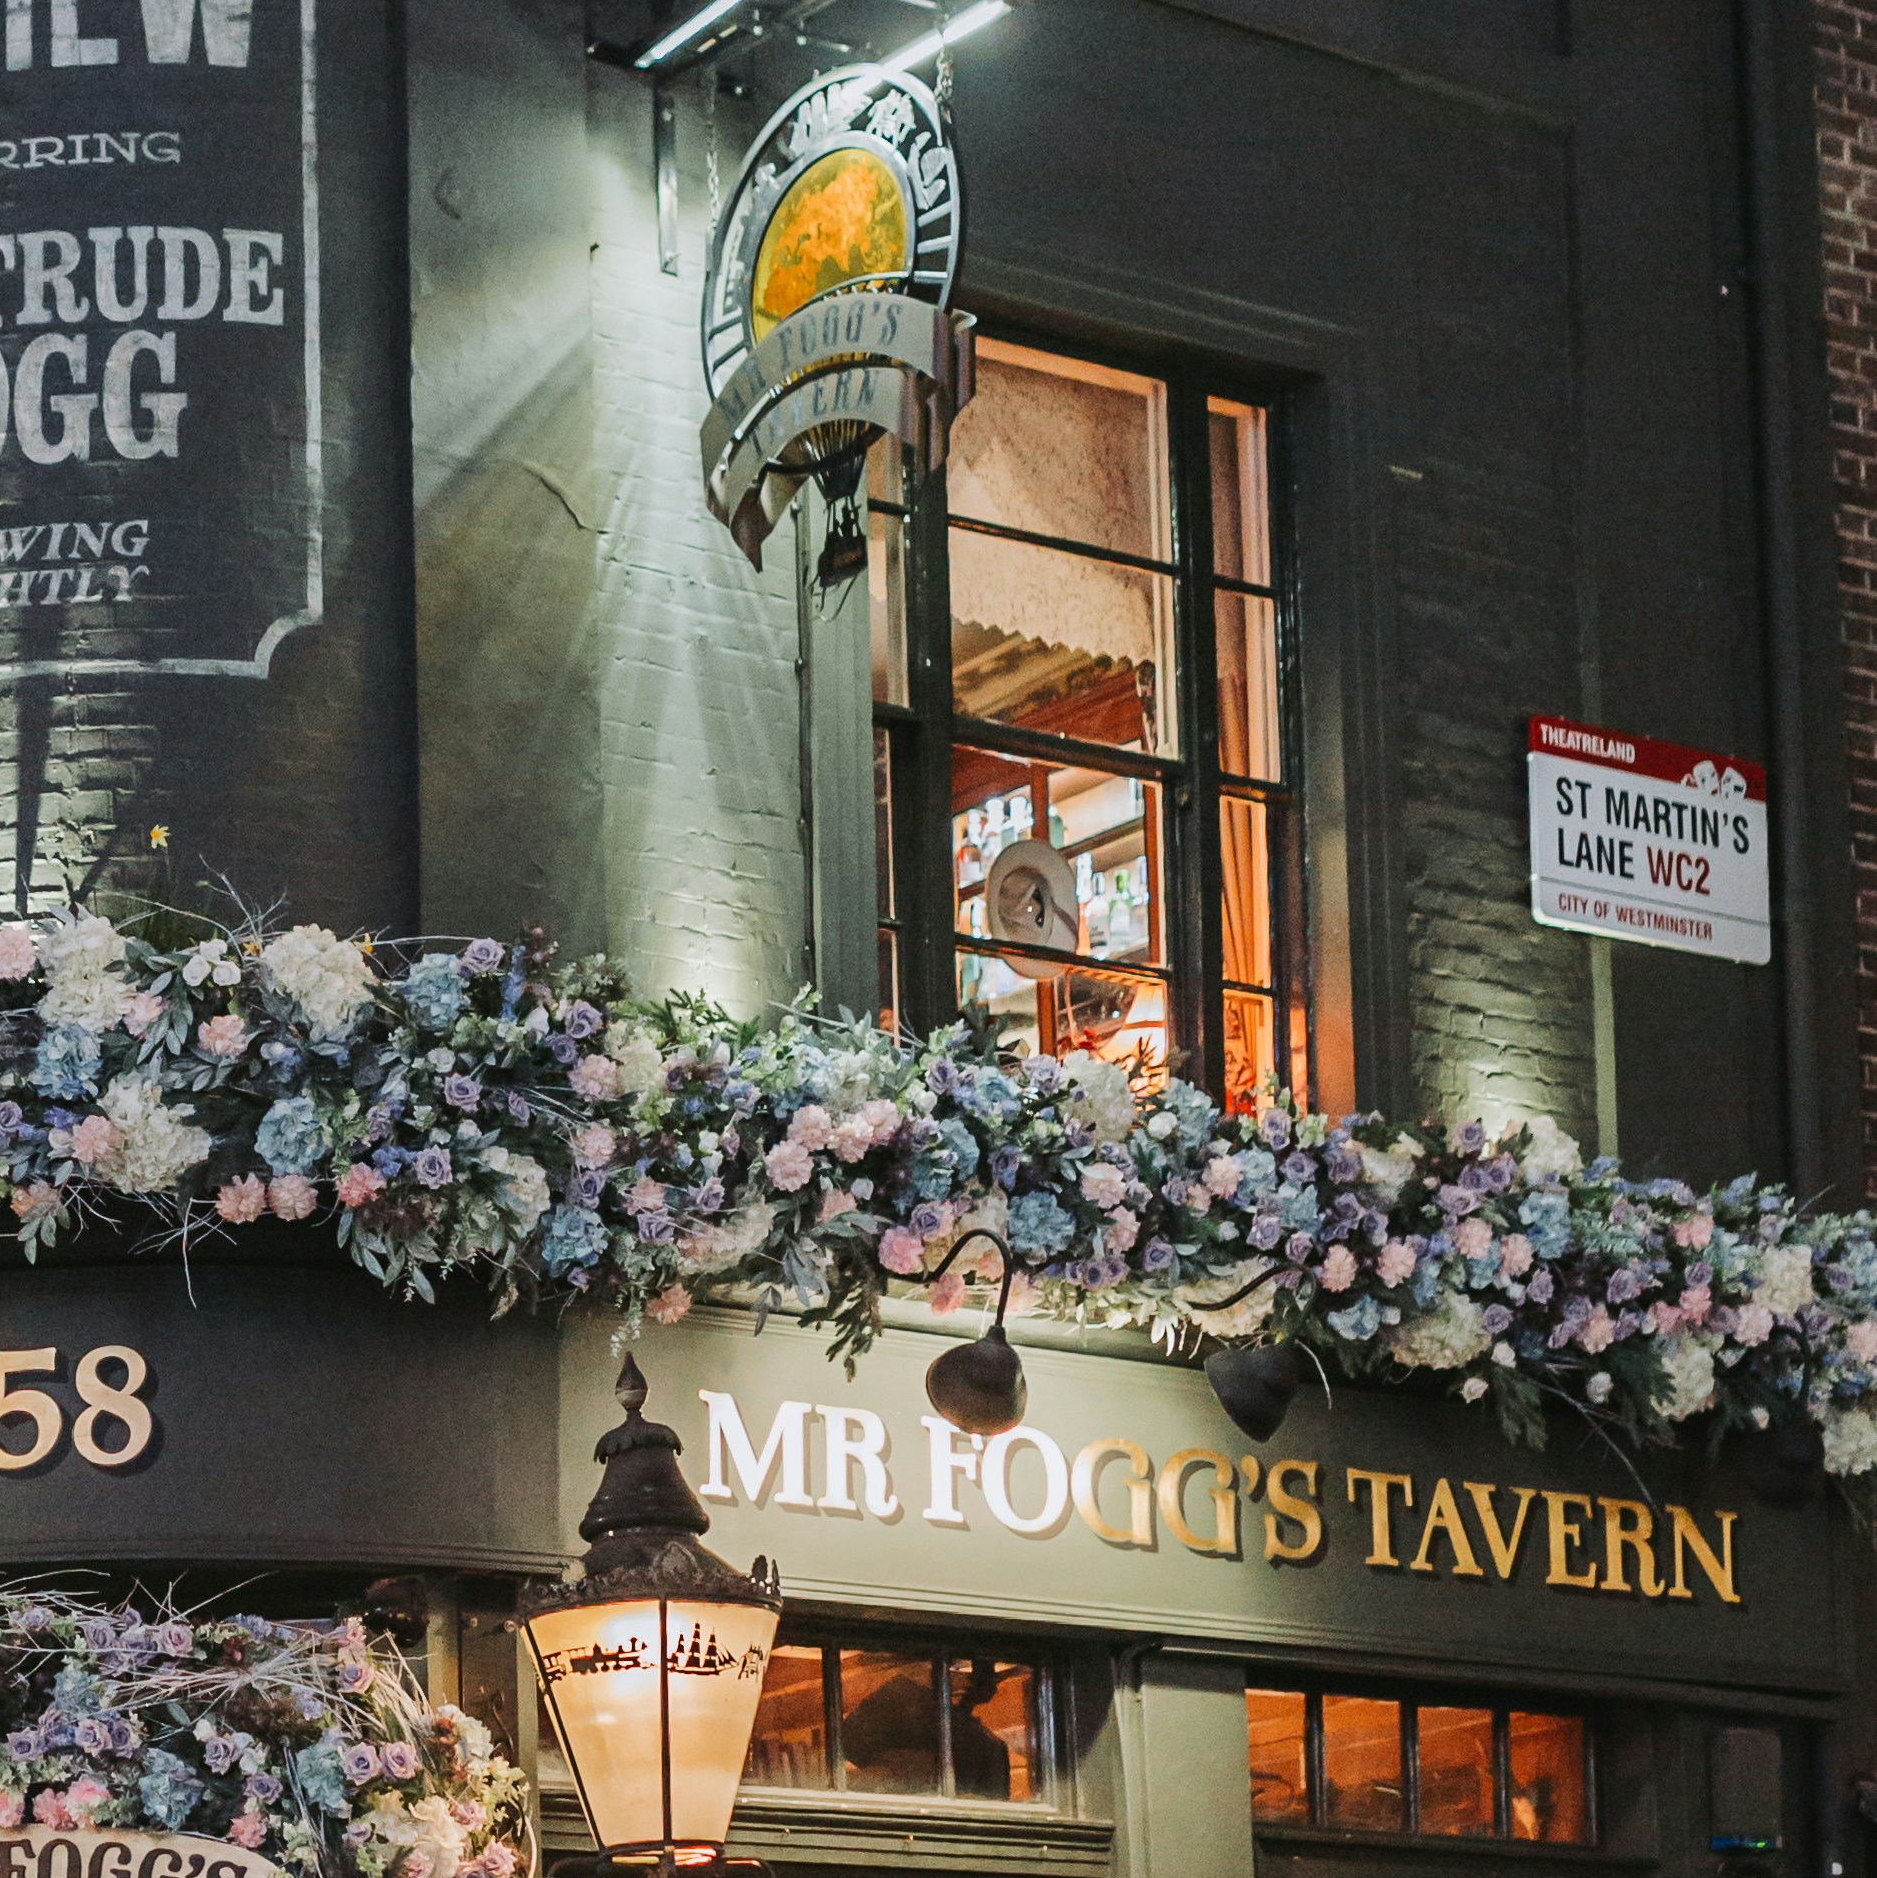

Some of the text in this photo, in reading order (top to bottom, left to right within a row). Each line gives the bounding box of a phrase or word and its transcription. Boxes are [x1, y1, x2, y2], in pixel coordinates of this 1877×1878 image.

[1539, 723, 1636, 764] THEATRELAND
[1556, 776, 1750, 855] ST MARTIN'S
[1557, 827, 1711, 896] LANE WC2
[1558, 892, 1713, 941] CITY OF WESTMINSTER
[698, 1388, 1742, 1604] MR FOGG'S TAVERN
